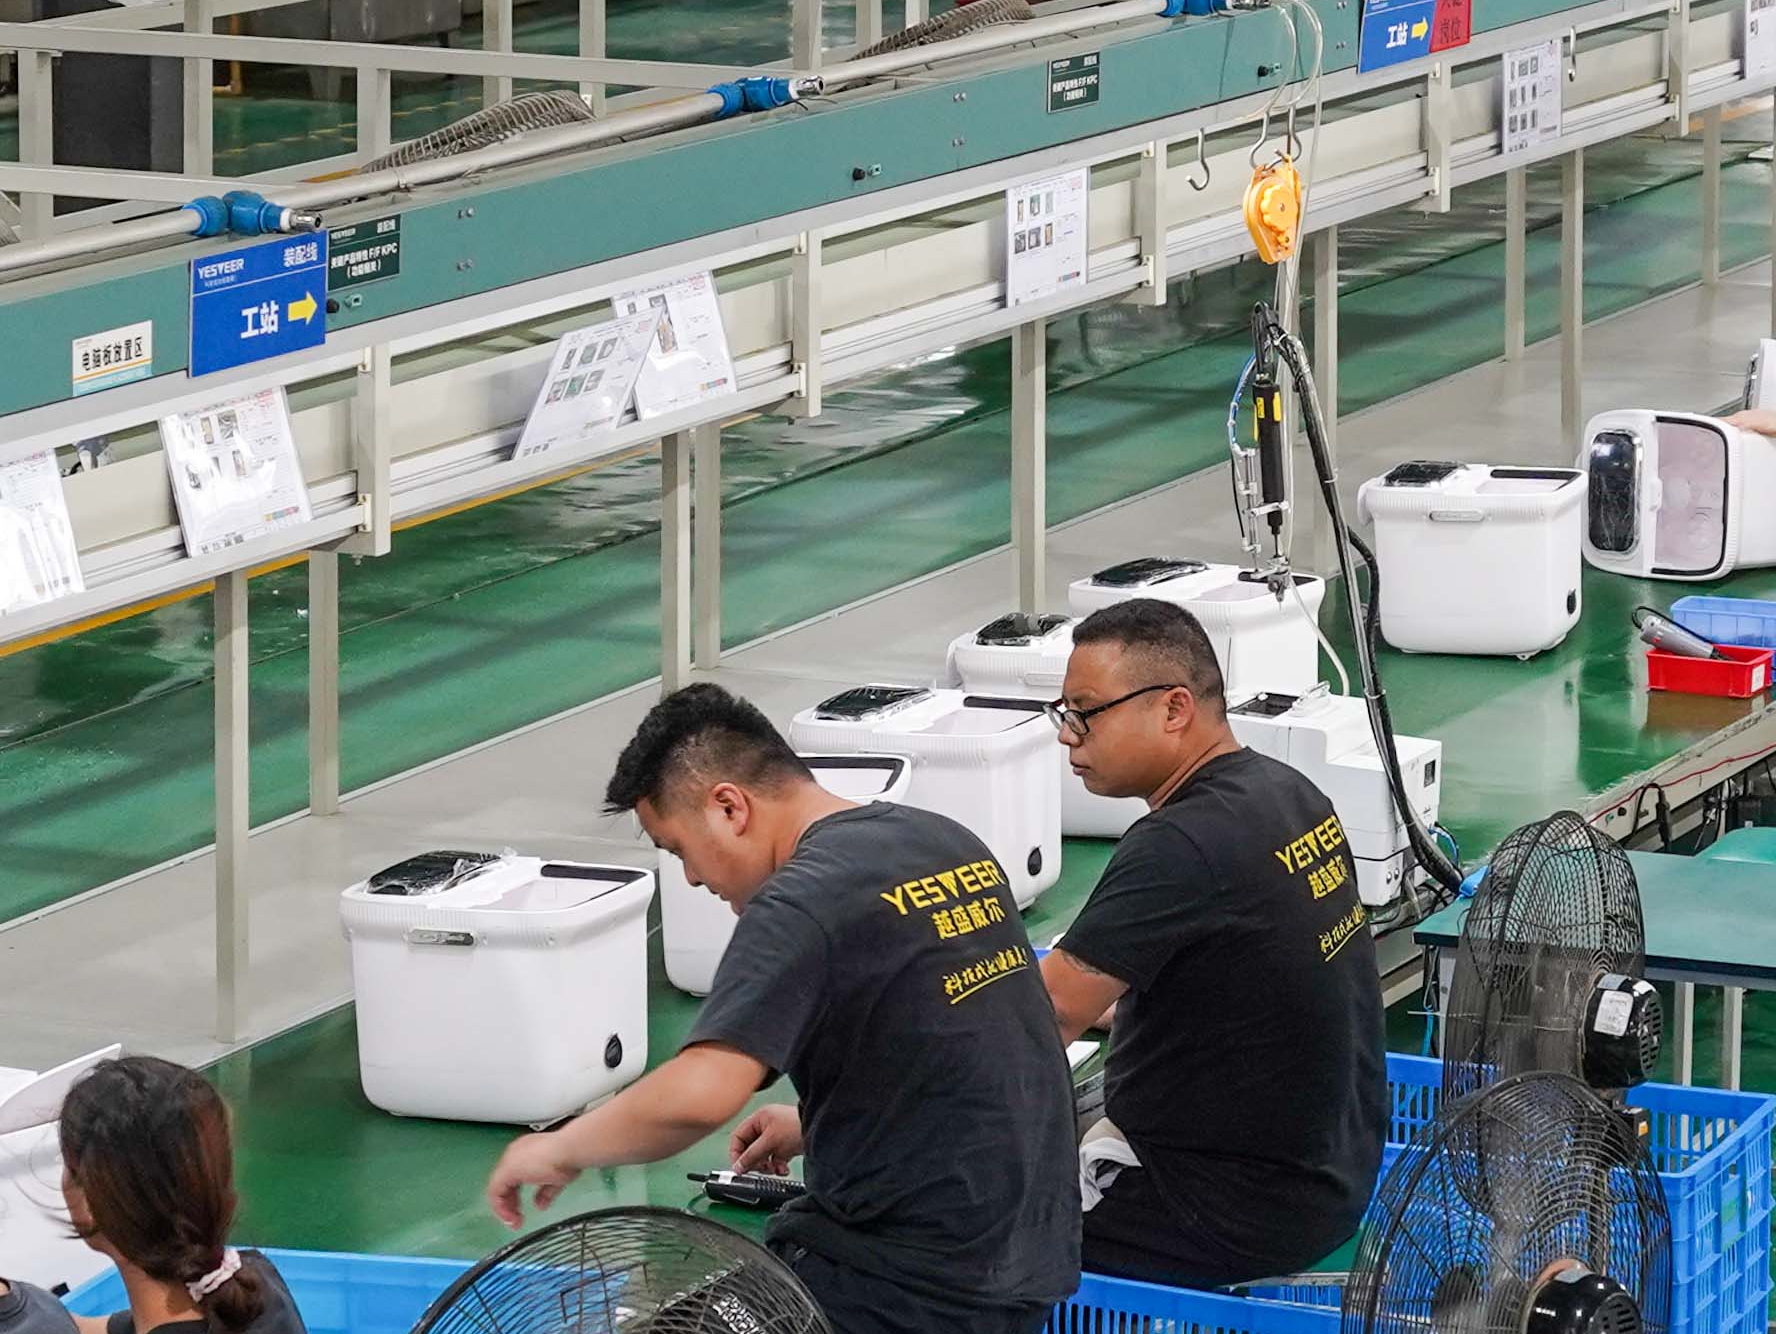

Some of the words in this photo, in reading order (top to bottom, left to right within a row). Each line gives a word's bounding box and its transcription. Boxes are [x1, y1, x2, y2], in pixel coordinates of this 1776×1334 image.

[1386, 21, 1408, 49] 工站
[283, 242, 318, 267] 装配线
[240, 300, 279, 339] 工站
[82, 336, 143, 371] 电脑板放置区
[930, 897, 1005, 939] 越盛威尔
